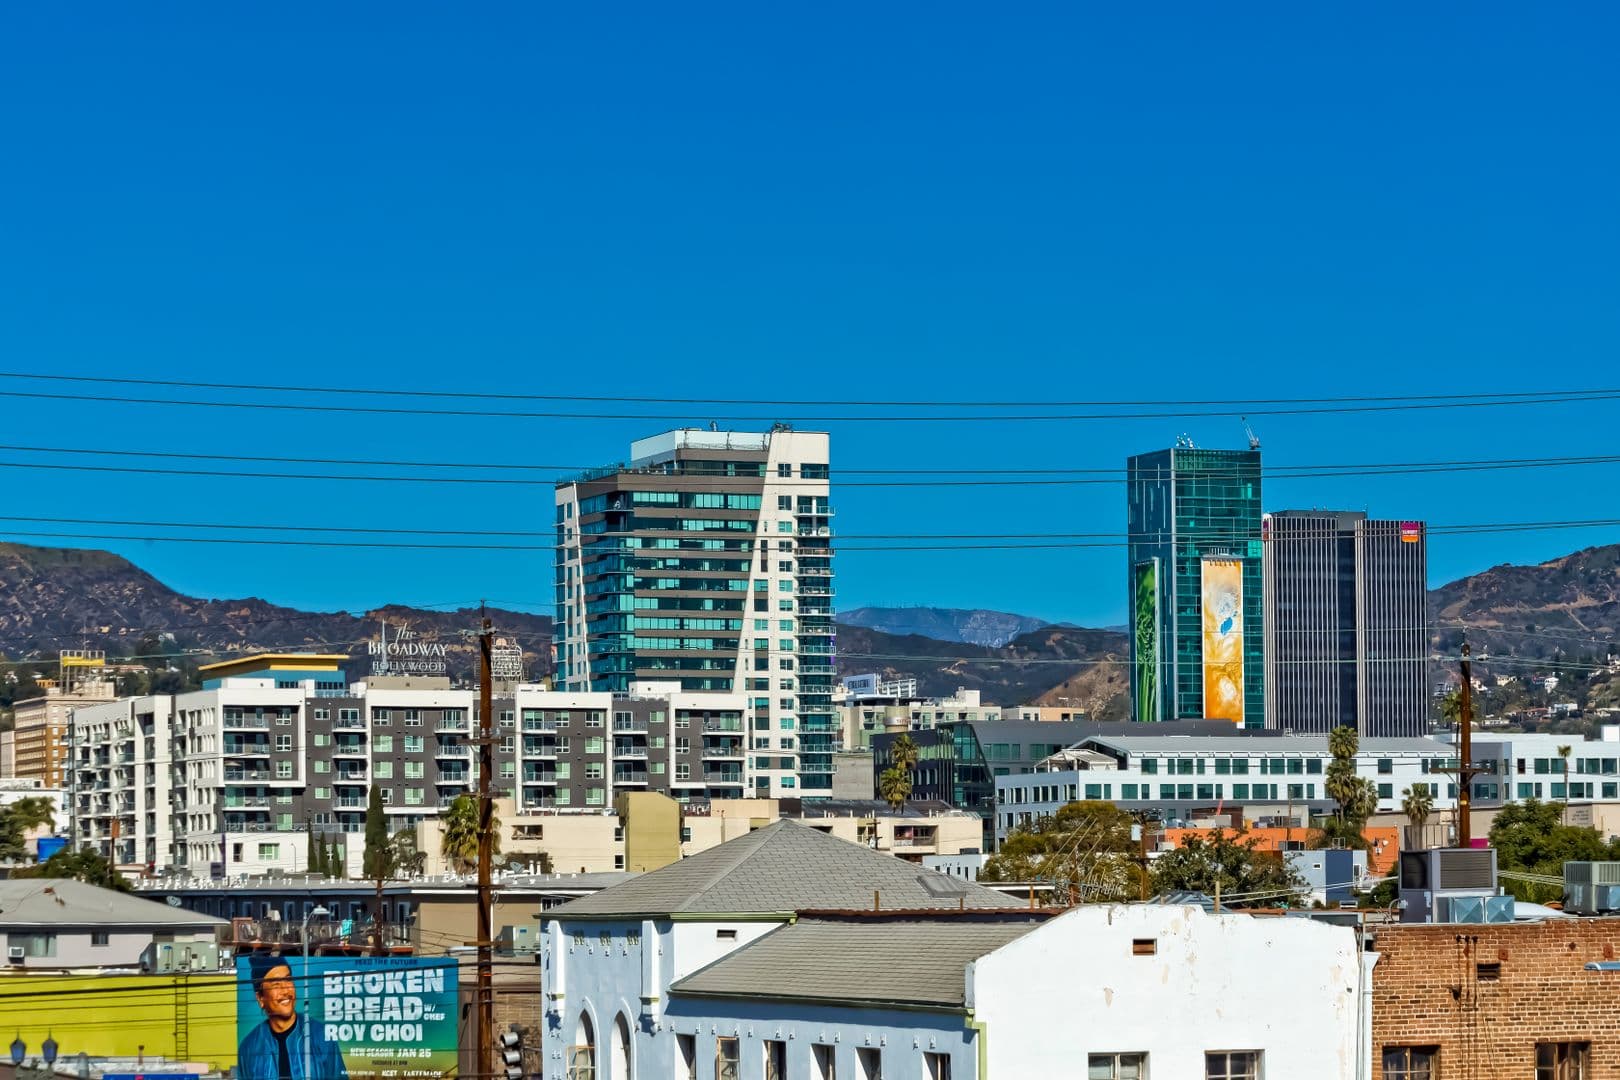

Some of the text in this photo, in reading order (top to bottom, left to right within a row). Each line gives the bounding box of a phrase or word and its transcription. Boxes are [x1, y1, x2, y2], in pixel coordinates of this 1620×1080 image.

[368, 640, 448, 656] BROADWAY
[372, 660, 446, 672] HOLLYWOOD
[323, 968, 444, 994] BROKEN
[324, 997, 423, 1021] BREAD
[324, 1024, 423, 1041] ROY CHOI
[397, 1049, 417, 1058] JAN
